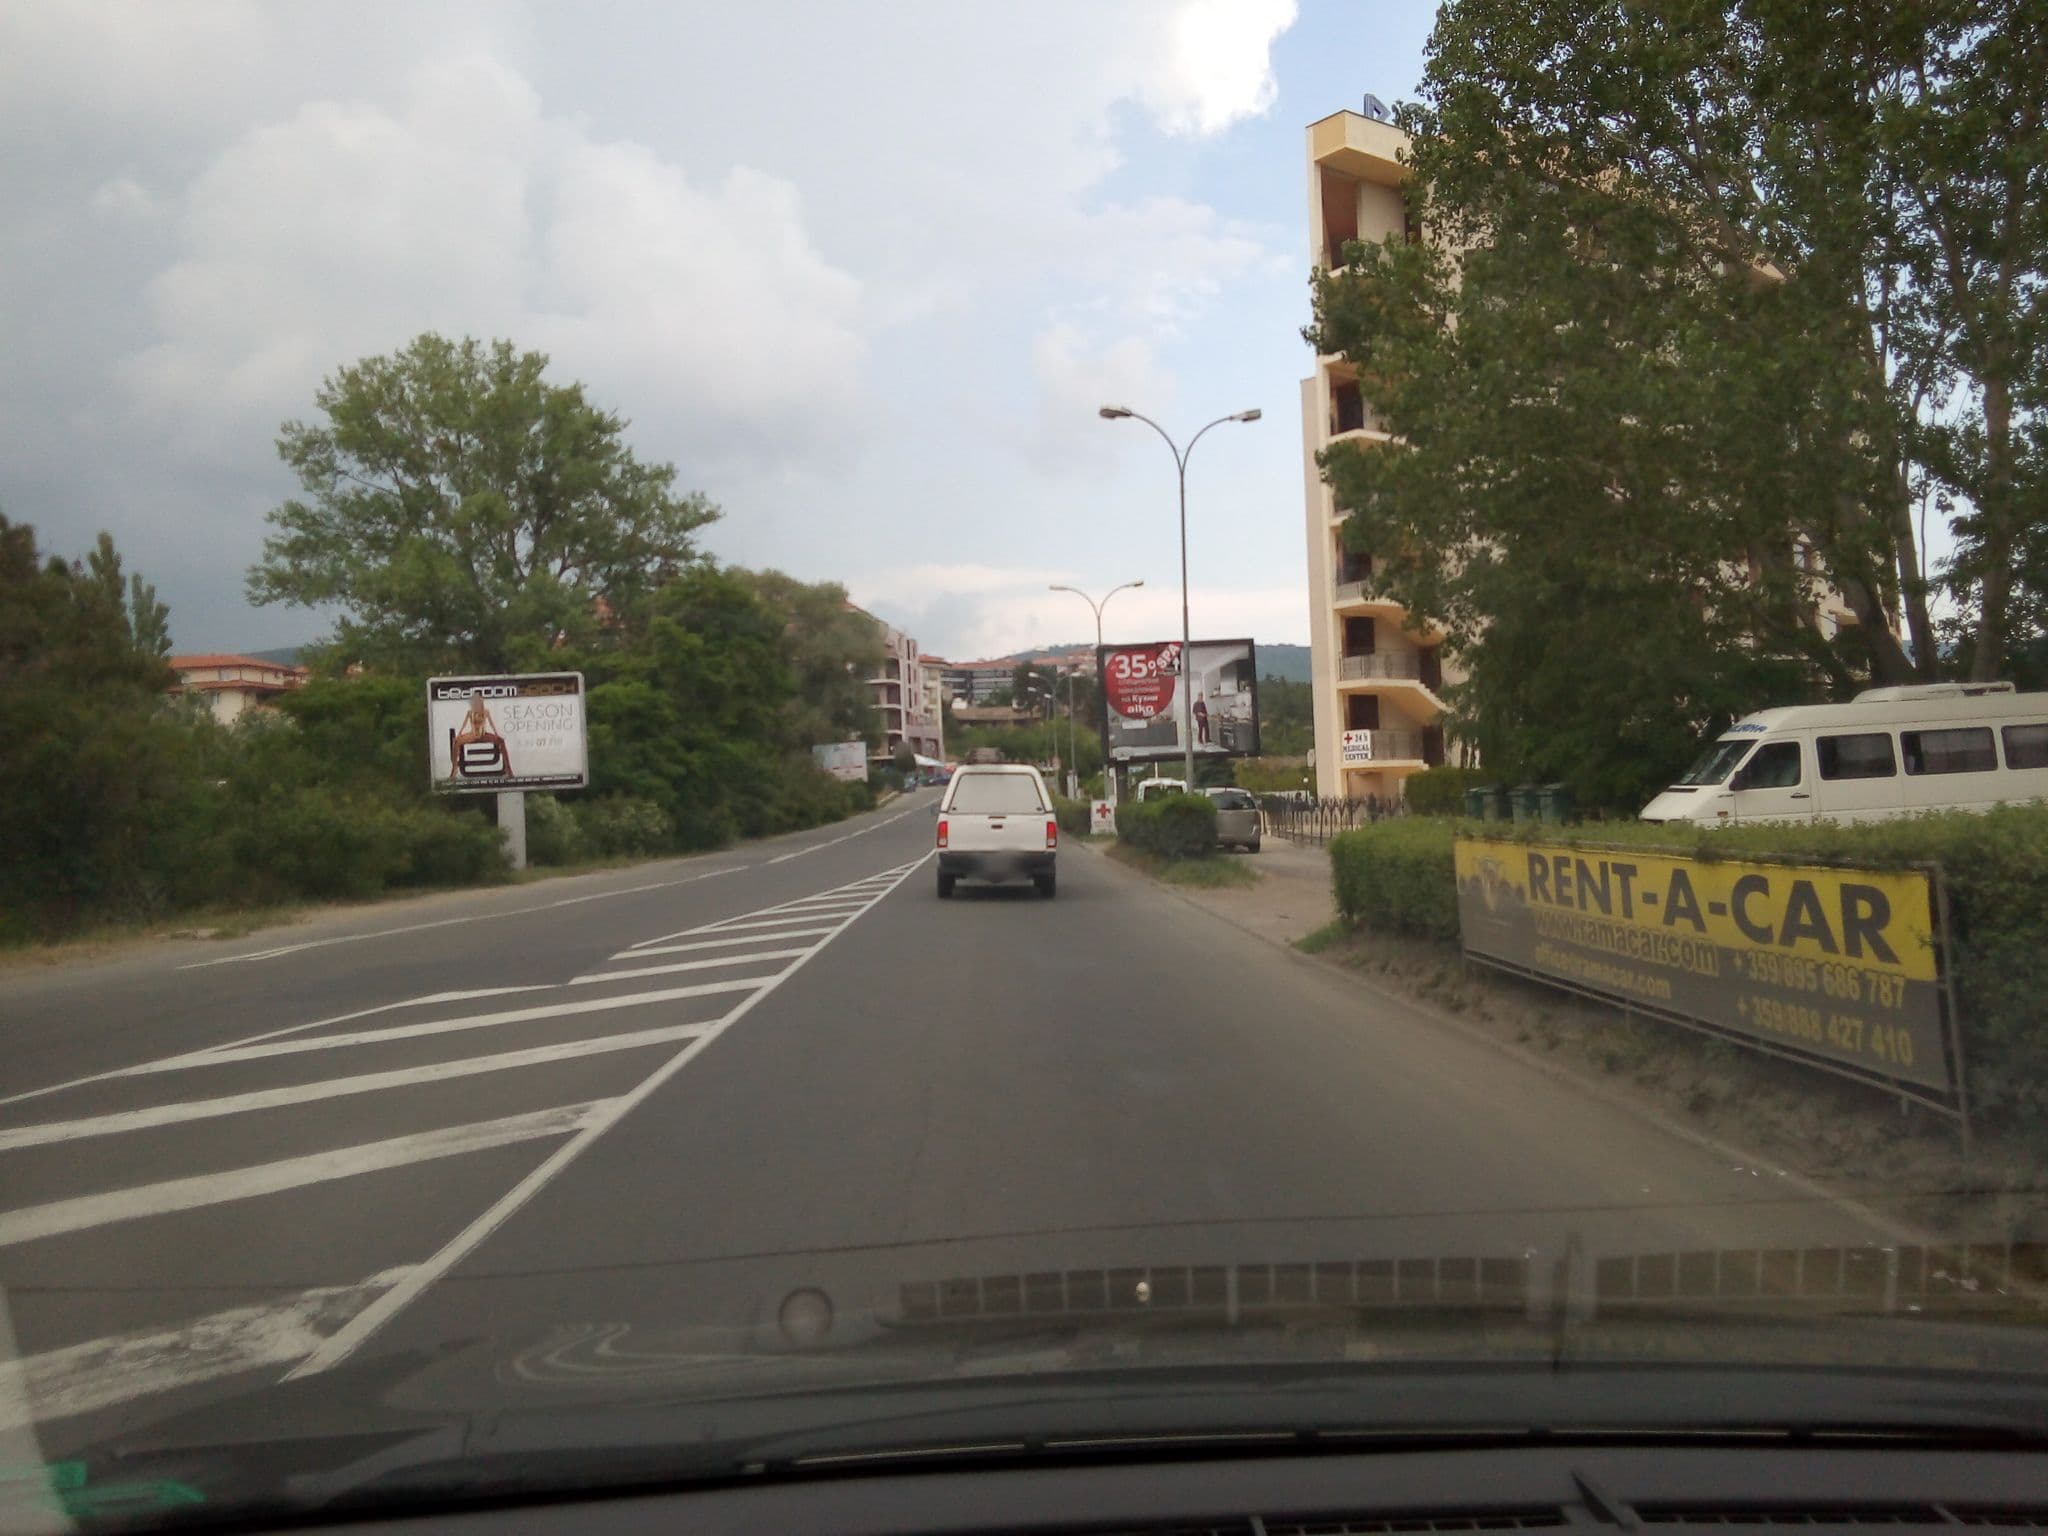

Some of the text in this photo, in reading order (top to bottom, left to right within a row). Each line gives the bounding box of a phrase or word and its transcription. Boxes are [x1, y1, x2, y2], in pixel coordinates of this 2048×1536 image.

[437, 686, 518, 700] bedroom
[503, 704, 573, 720] SEASON
[503, 718, 573, 733] OPENING
[1527, 851, 1901, 965] RENT-A-CAR
